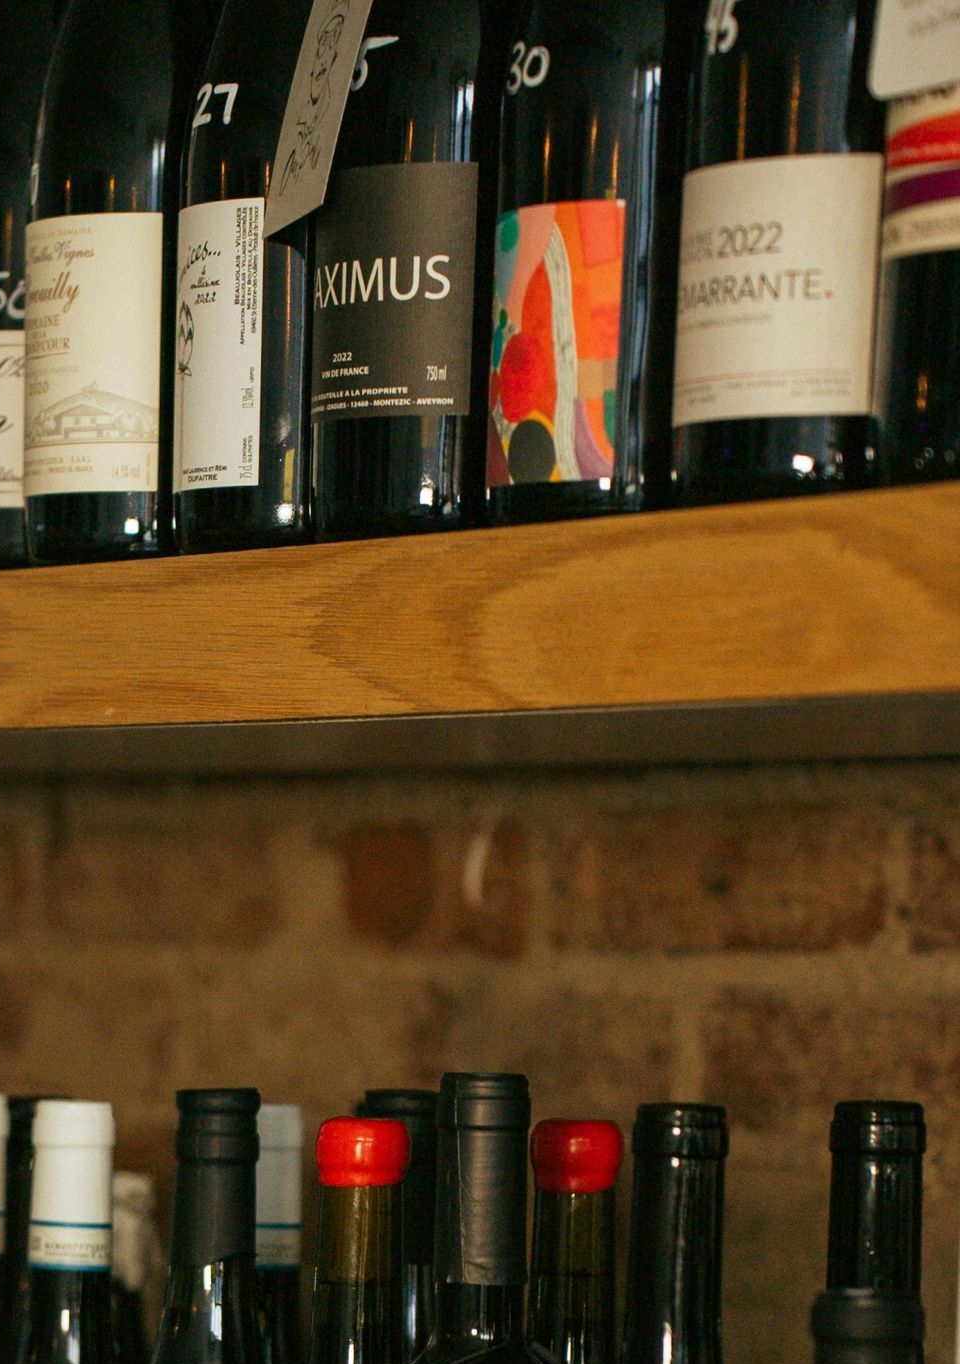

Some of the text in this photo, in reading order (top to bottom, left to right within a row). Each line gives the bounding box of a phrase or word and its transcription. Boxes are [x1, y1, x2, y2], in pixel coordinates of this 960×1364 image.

[506, 40, 550, 95] 30
[191, 82, 239, 126] 27
[718, 220, 784, 259] 2022
[54, 240, 95, 267] Vignes
[331, 351, 353, 364] 2022
[321, 366, 370, 379] VIN DE FRANCE
[426, 365, 447, 381] 750 ml
[351, 388, 361, 397] LA
[361, 386, 408, 396] PROPRIETE
[373, 398, 411, 407] MONTEZIC
[416, 397, 454, 406] AVEYRON
